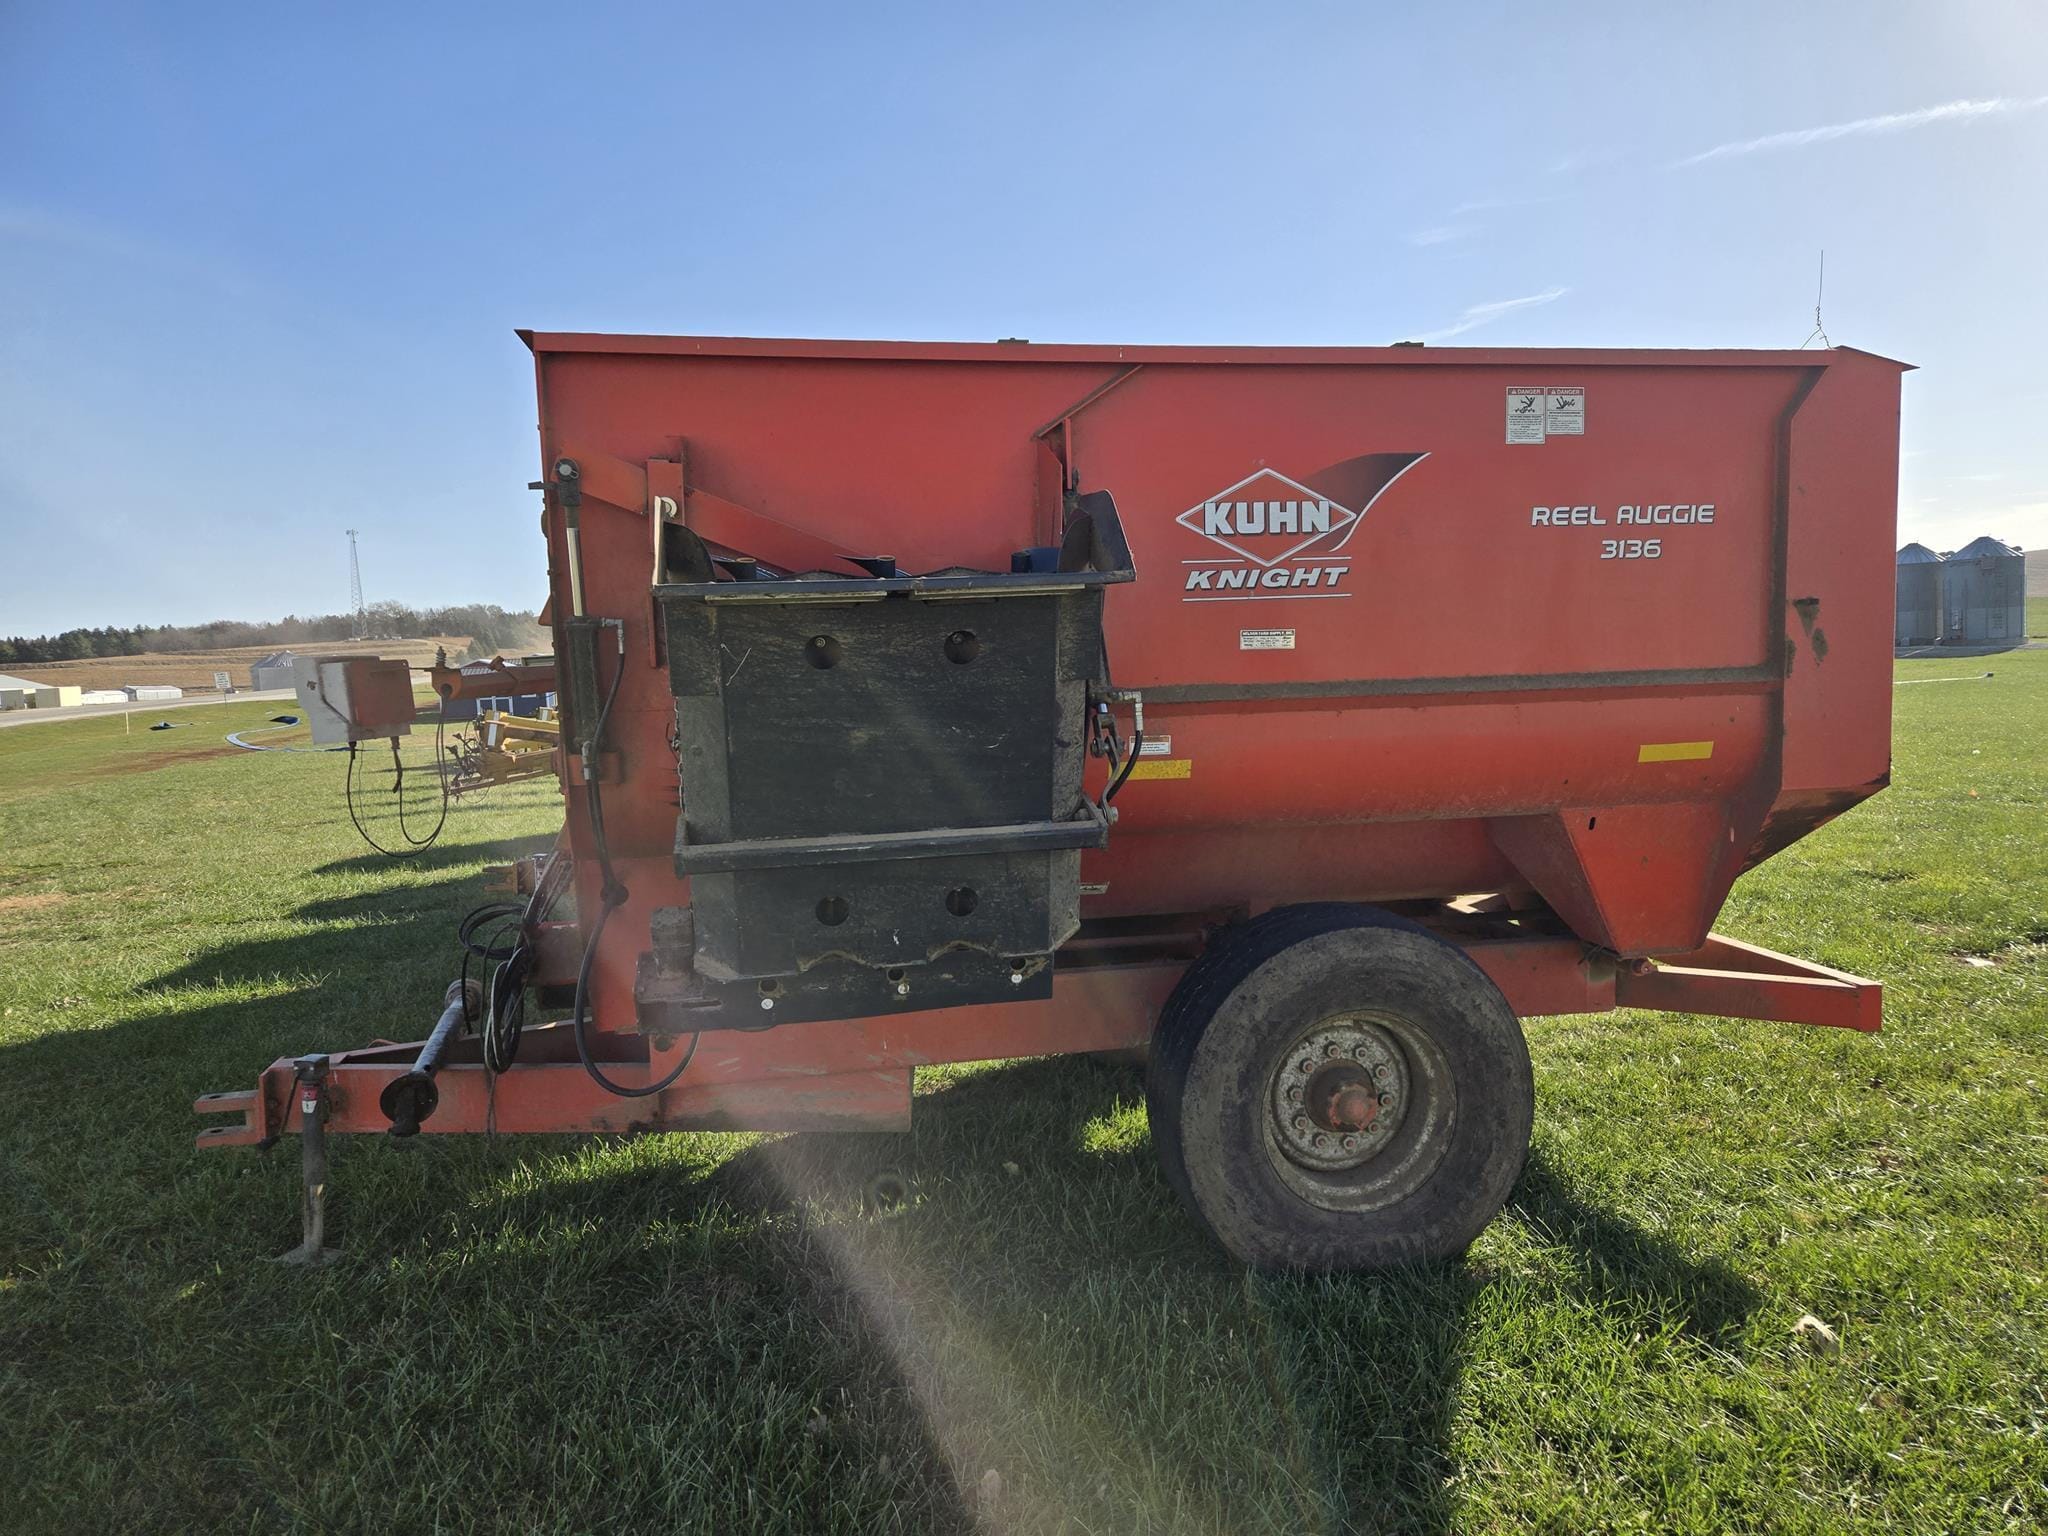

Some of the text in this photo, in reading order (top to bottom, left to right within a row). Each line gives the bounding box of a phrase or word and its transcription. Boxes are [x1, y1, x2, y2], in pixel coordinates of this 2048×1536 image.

[1203, 500, 1331, 536] KUHN
[1531, 504, 1715, 526] REEL AUGGIE
[1600, 539, 1662, 559] 3136
[1184, 566, 1349, 590] KNIGHT
